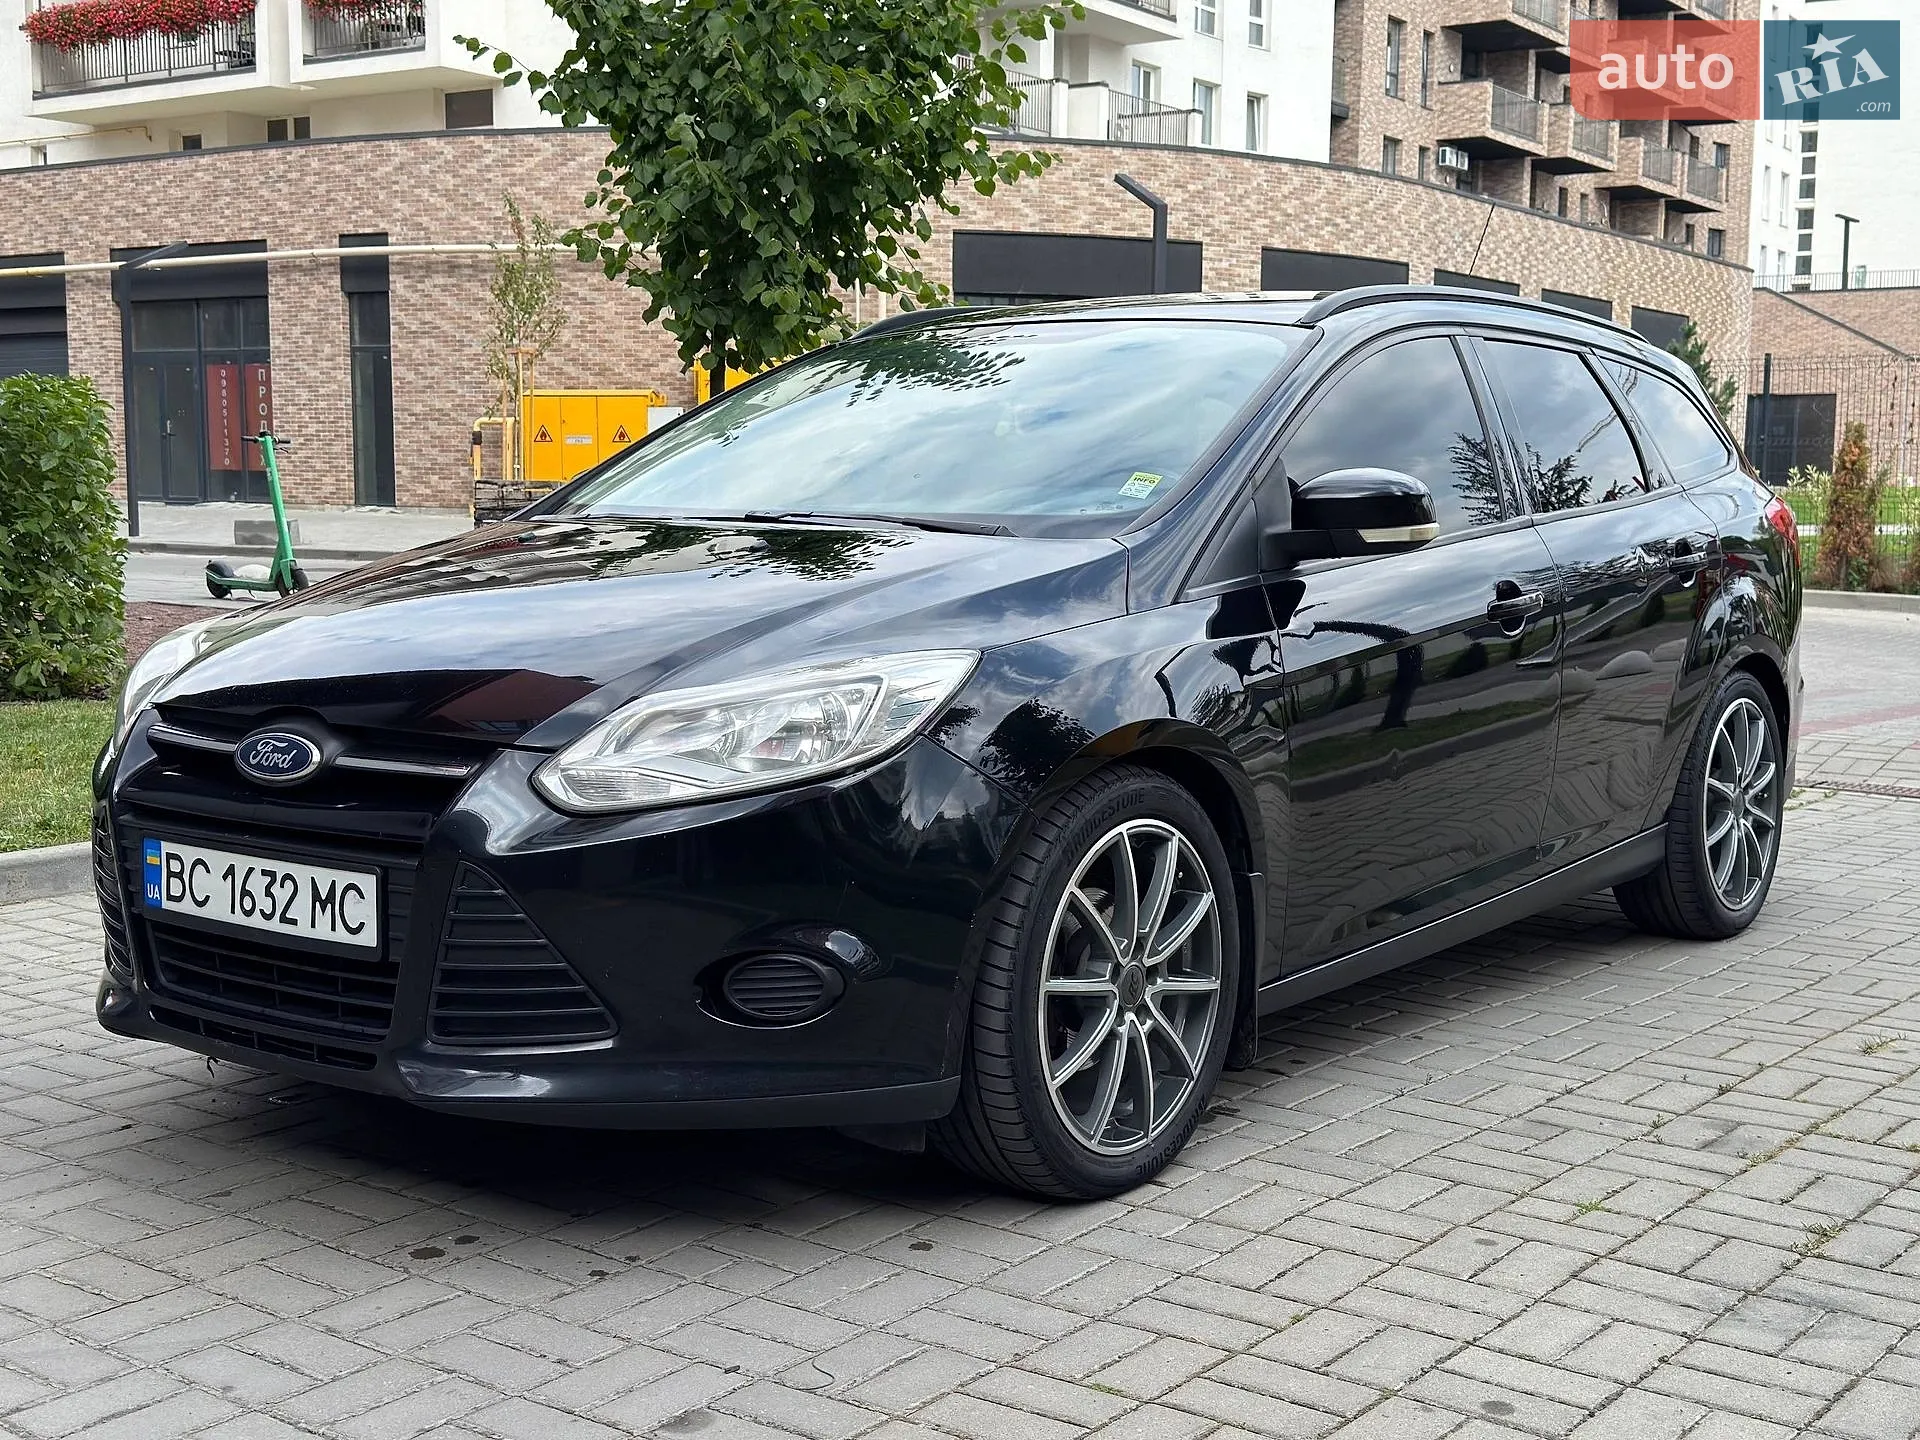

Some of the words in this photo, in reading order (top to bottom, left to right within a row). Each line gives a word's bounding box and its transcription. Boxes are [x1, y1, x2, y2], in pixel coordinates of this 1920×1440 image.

[220, 369, 230, 465] 0980511370
[249, 739, 298, 769] Ford
[147, 883, 160, 900] UA
[165, 851, 211, 908] BC
[222, 863, 299, 926] 1632
[310, 876, 366, 935] MC
